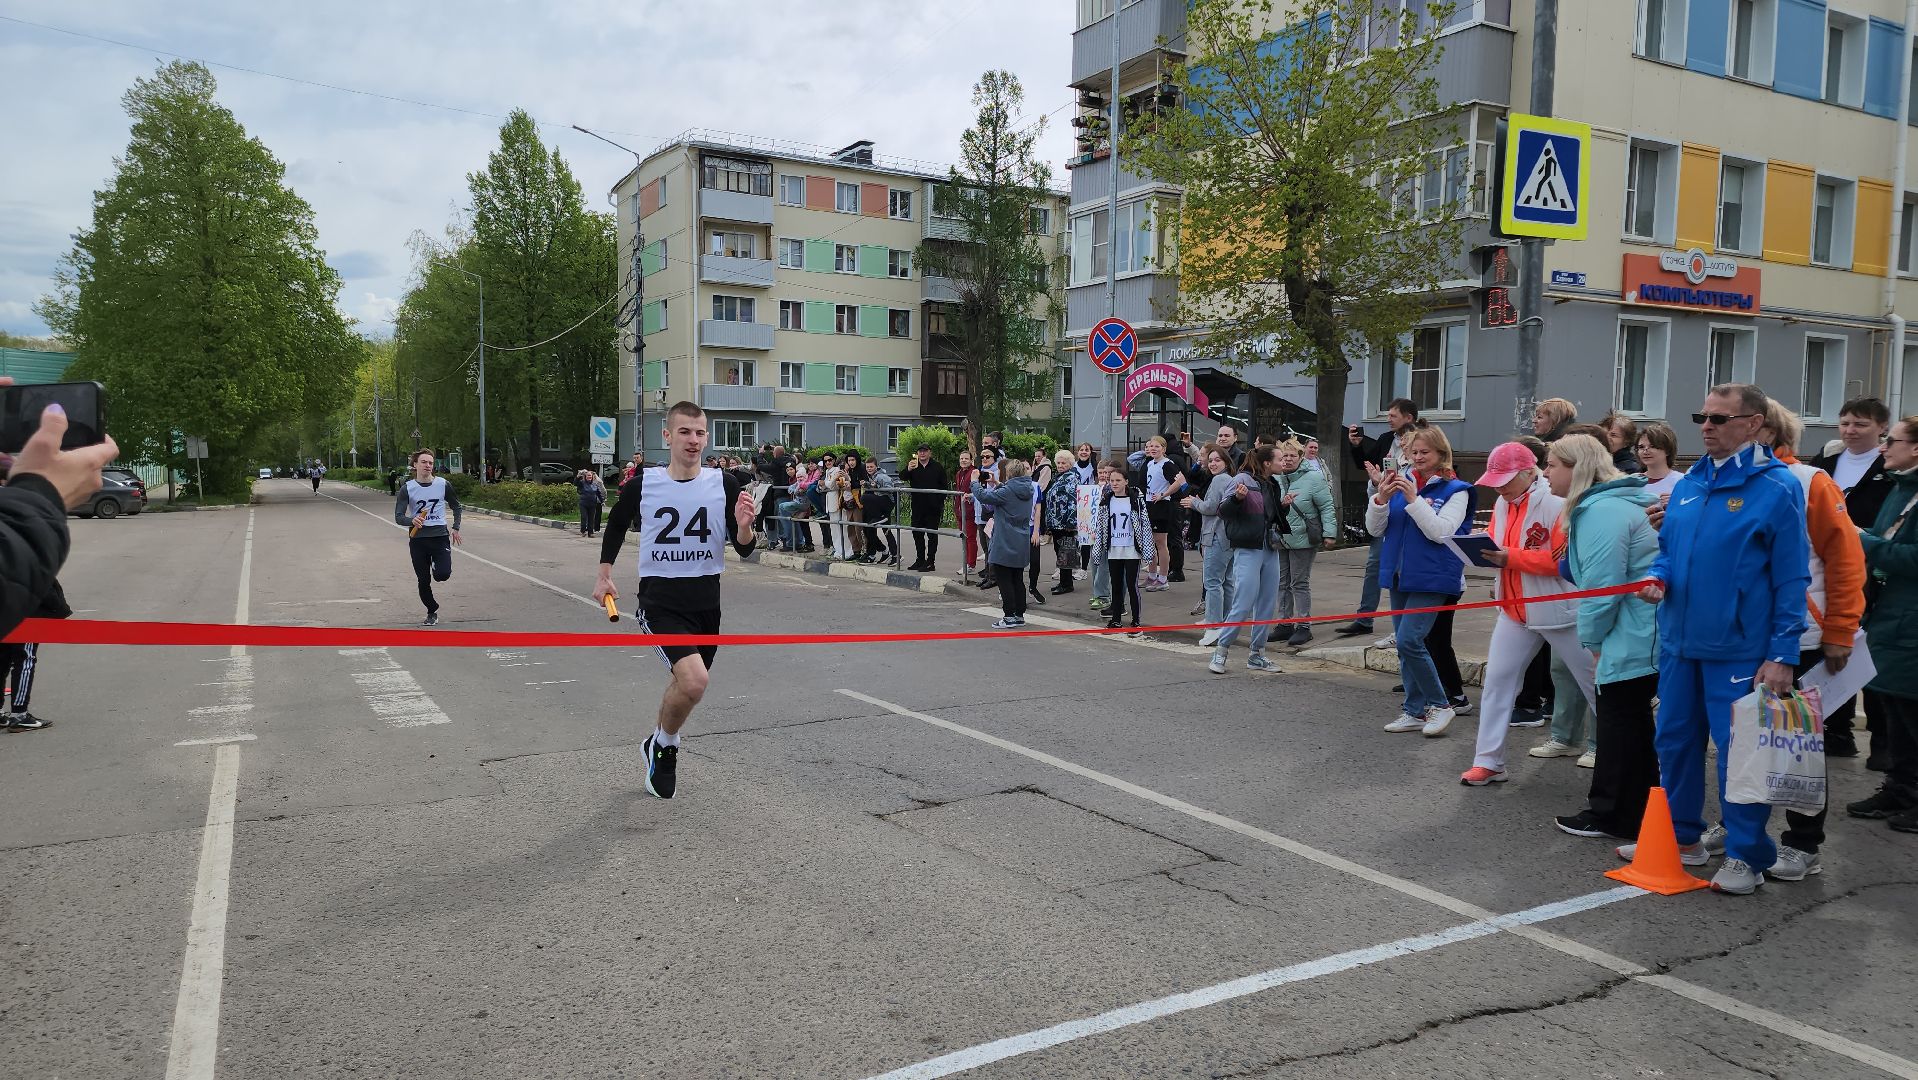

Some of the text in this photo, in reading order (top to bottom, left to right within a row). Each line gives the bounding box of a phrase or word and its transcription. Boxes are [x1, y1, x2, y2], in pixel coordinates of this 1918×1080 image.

[1640, 284, 1753, 309] КОМПЬЮТЕРЫ
[1128, 368, 1184, 394] ПРЕМЬЕР
[416, 499, 440, 514] 27
[654, 506, 712, 544] 24
[1110, 513, 1129, 530] 17
[651, 550, 714, 562] КАШИРА
